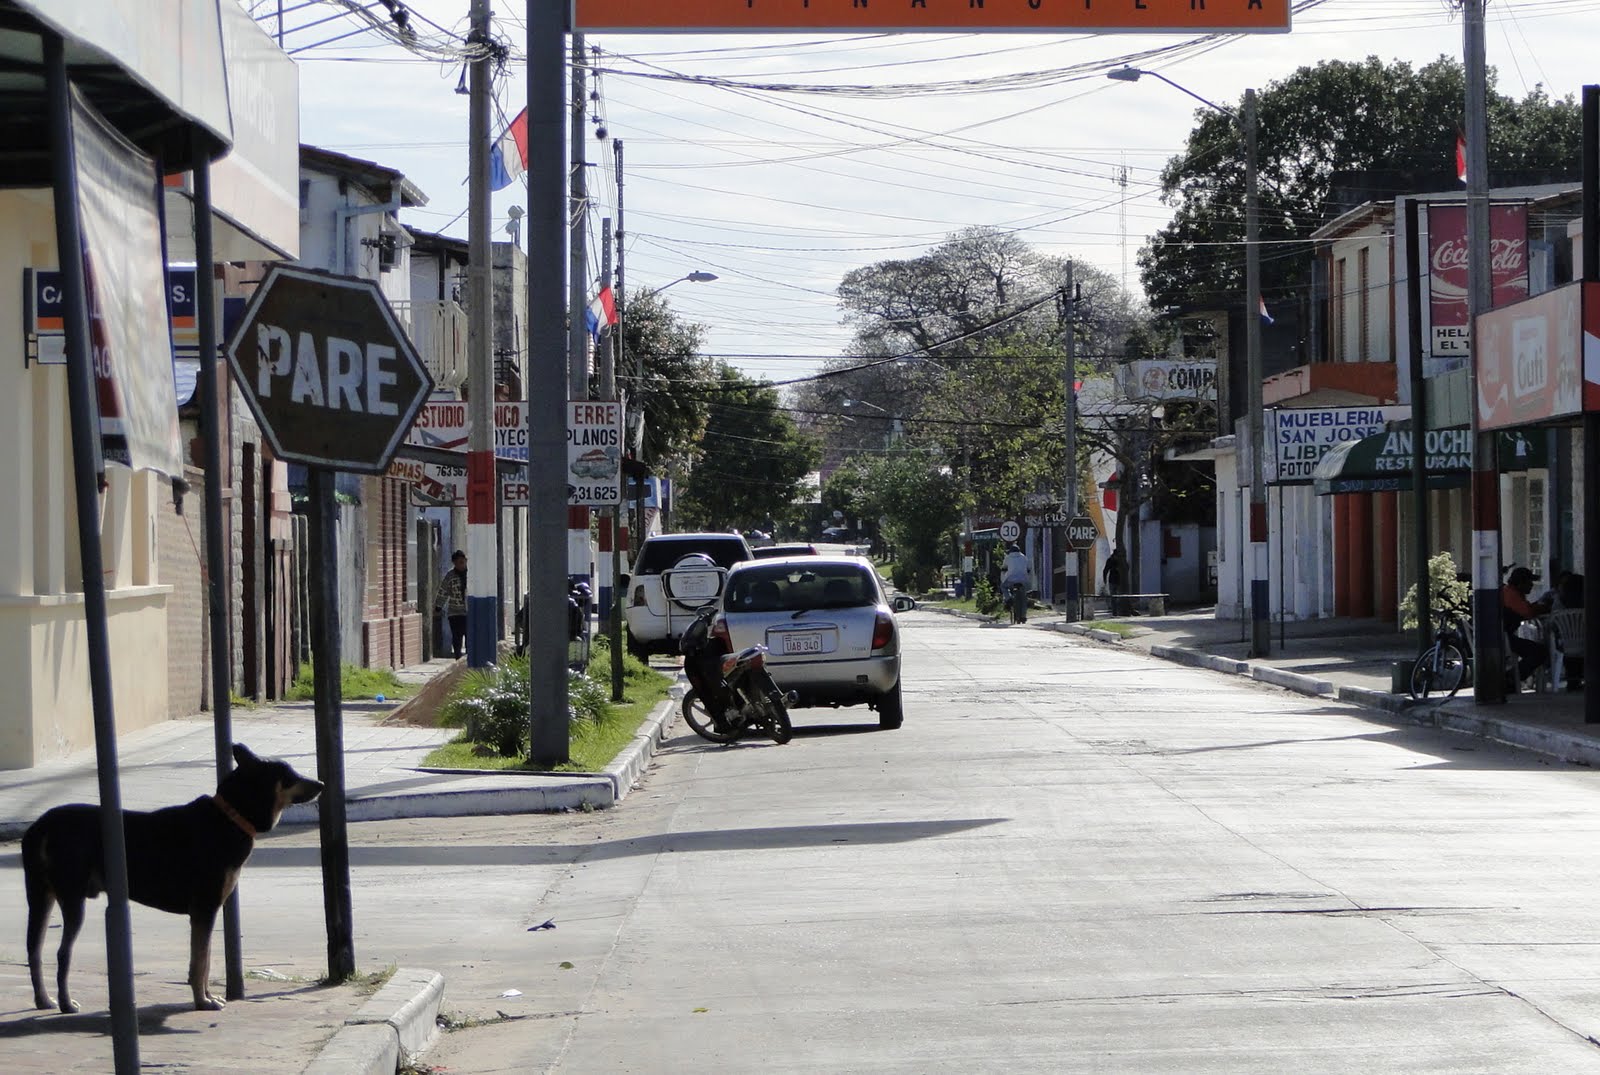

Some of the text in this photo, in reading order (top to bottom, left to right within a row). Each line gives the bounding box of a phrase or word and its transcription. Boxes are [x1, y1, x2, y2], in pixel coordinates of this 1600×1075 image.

[1436, 328, 1469, 338] HEL
[257, 323, 399, 416] PARE
[1279, 410, 1385, 428] MUEBLERIA
[1279, 429, 1316, 444] SAN
[389, 461, 422, 480] OPIAS
[1002, 525, 1018, 537] 30
[1069, 526, 1096, 541] PARE
[786, 642, 802, 651] UAB
